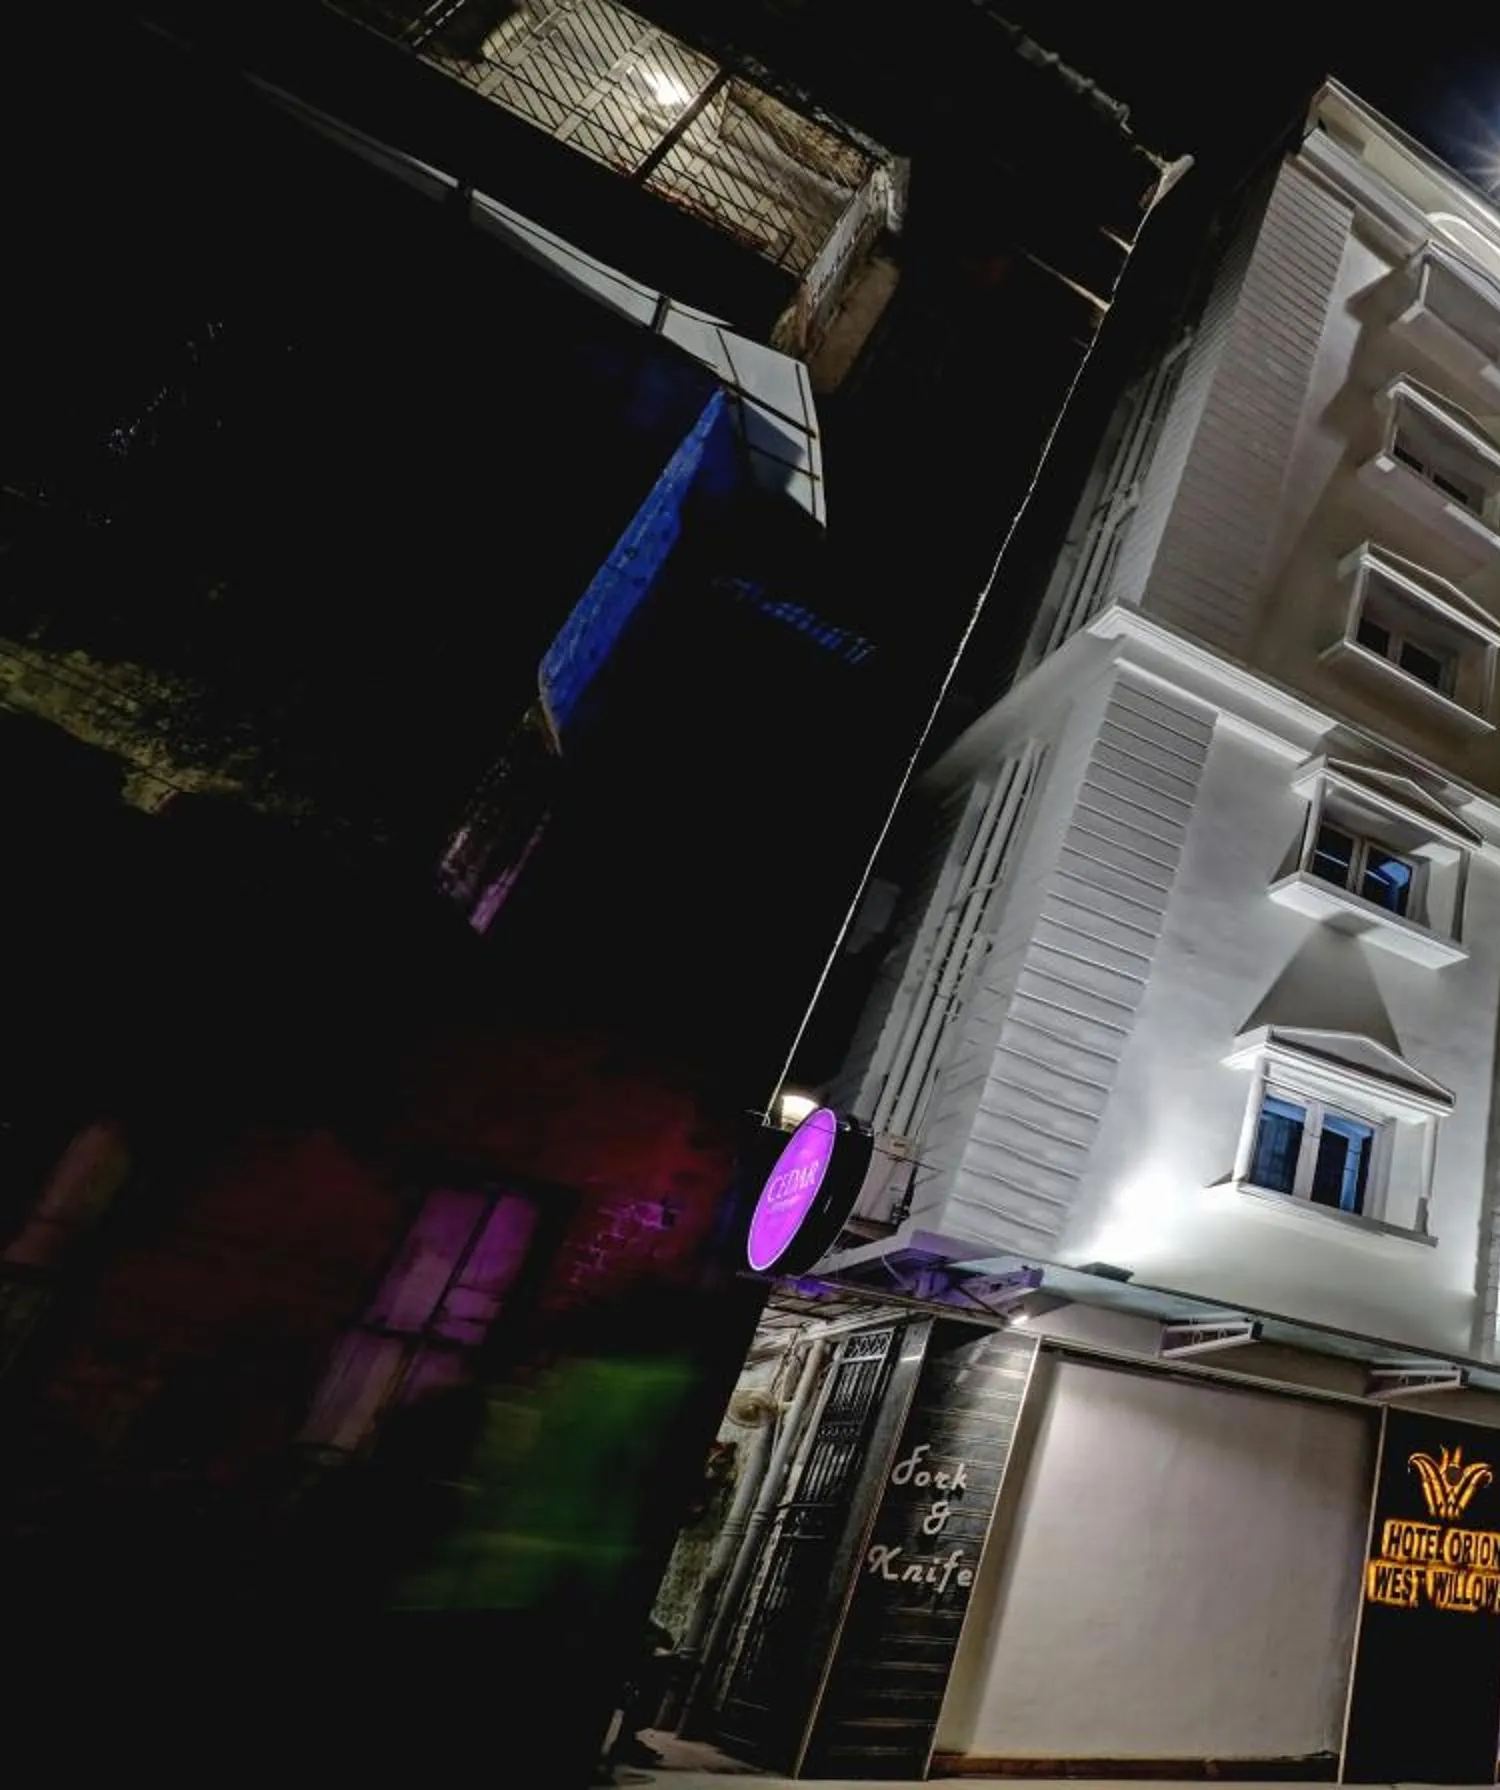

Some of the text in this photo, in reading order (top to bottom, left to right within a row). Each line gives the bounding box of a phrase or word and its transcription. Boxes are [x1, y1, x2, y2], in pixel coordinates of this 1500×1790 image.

[891, 1443, 968, 1491] Fork
[1385, 1522, 1446, 1562] HOTEL
[867, 1544, 974, 1594] Knife
[1373, 1564, 1428, 1607] WEST
